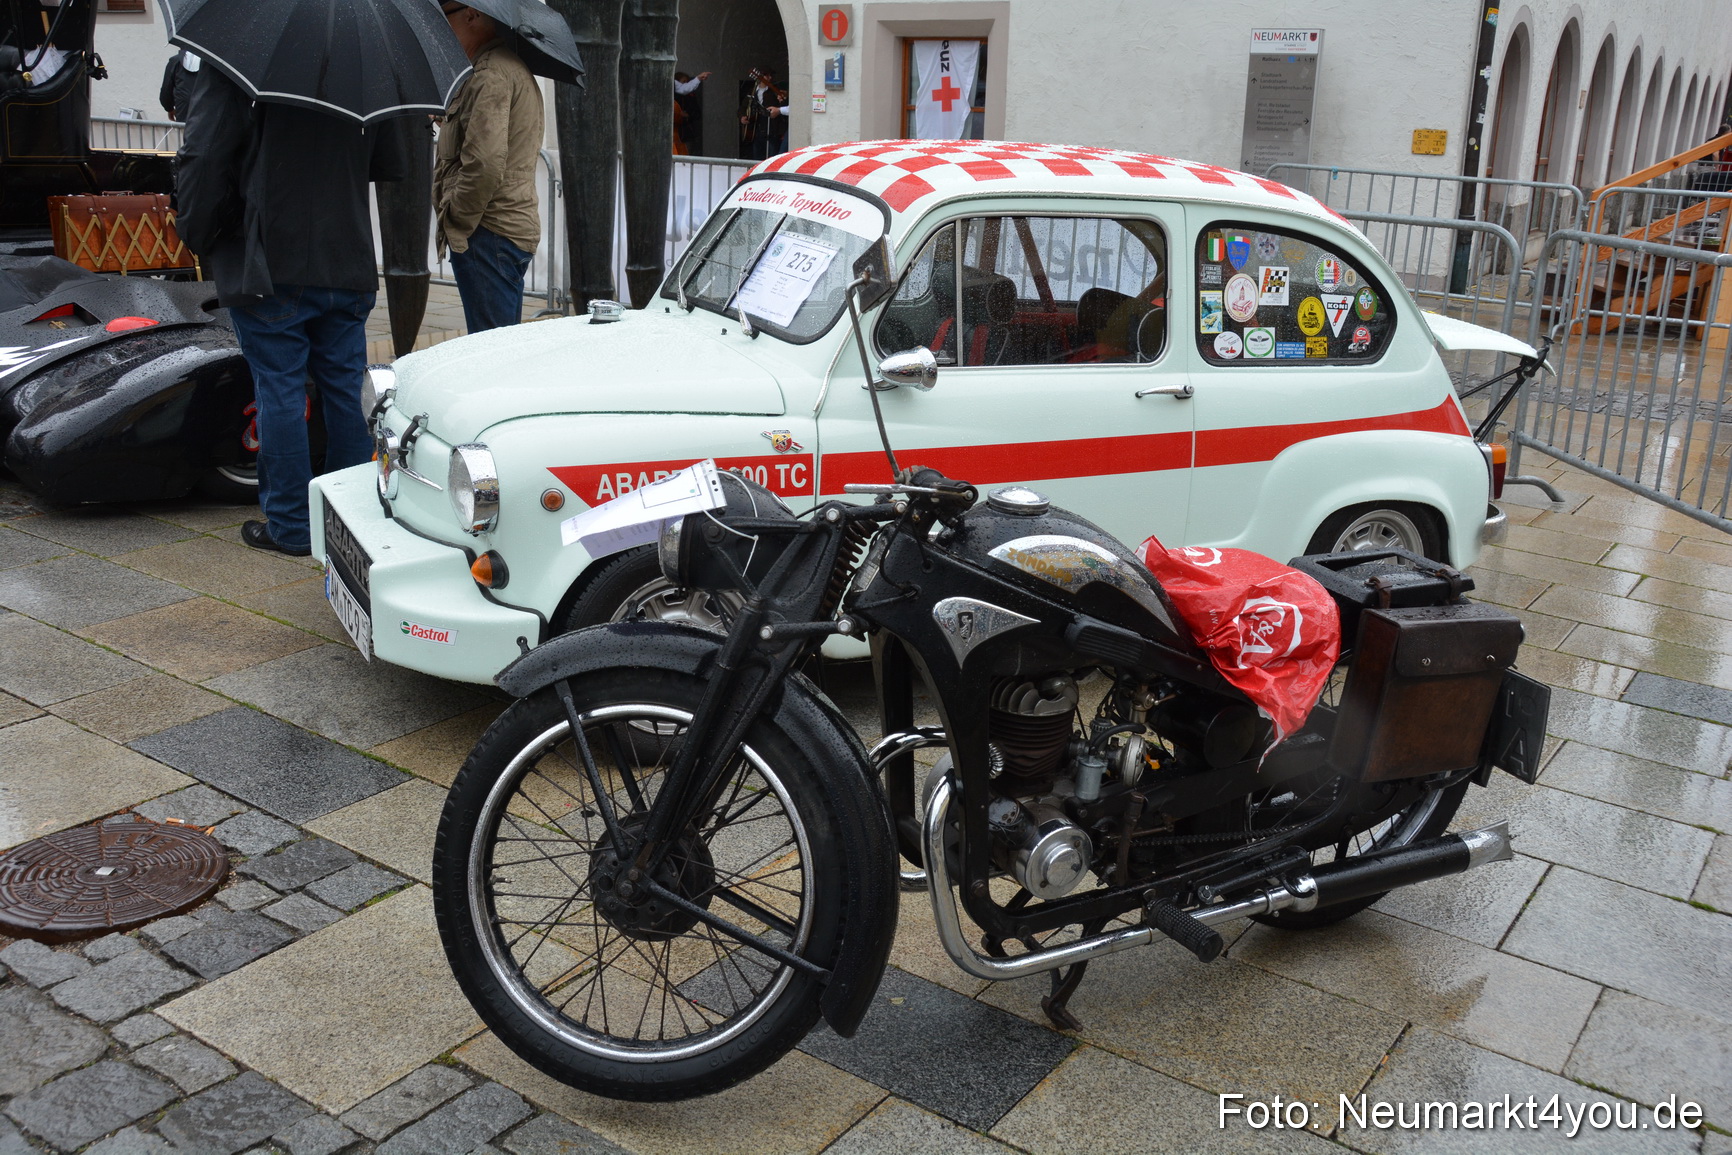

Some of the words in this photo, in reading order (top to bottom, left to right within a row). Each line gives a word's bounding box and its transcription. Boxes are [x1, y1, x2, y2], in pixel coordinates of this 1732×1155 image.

[1253, 31, 1308, 41] NEUMARKT
[738, 187, 787, 205] Scuderia
[789, 192, 852, 221] Topolino
[786, 252, 817, 273] 275
[596, 470, 681, 500] ABA
[718, 464, 768, 489] 00
[775, 463, 807, 489] TC
[411, 624, 449, 643] Castrol
